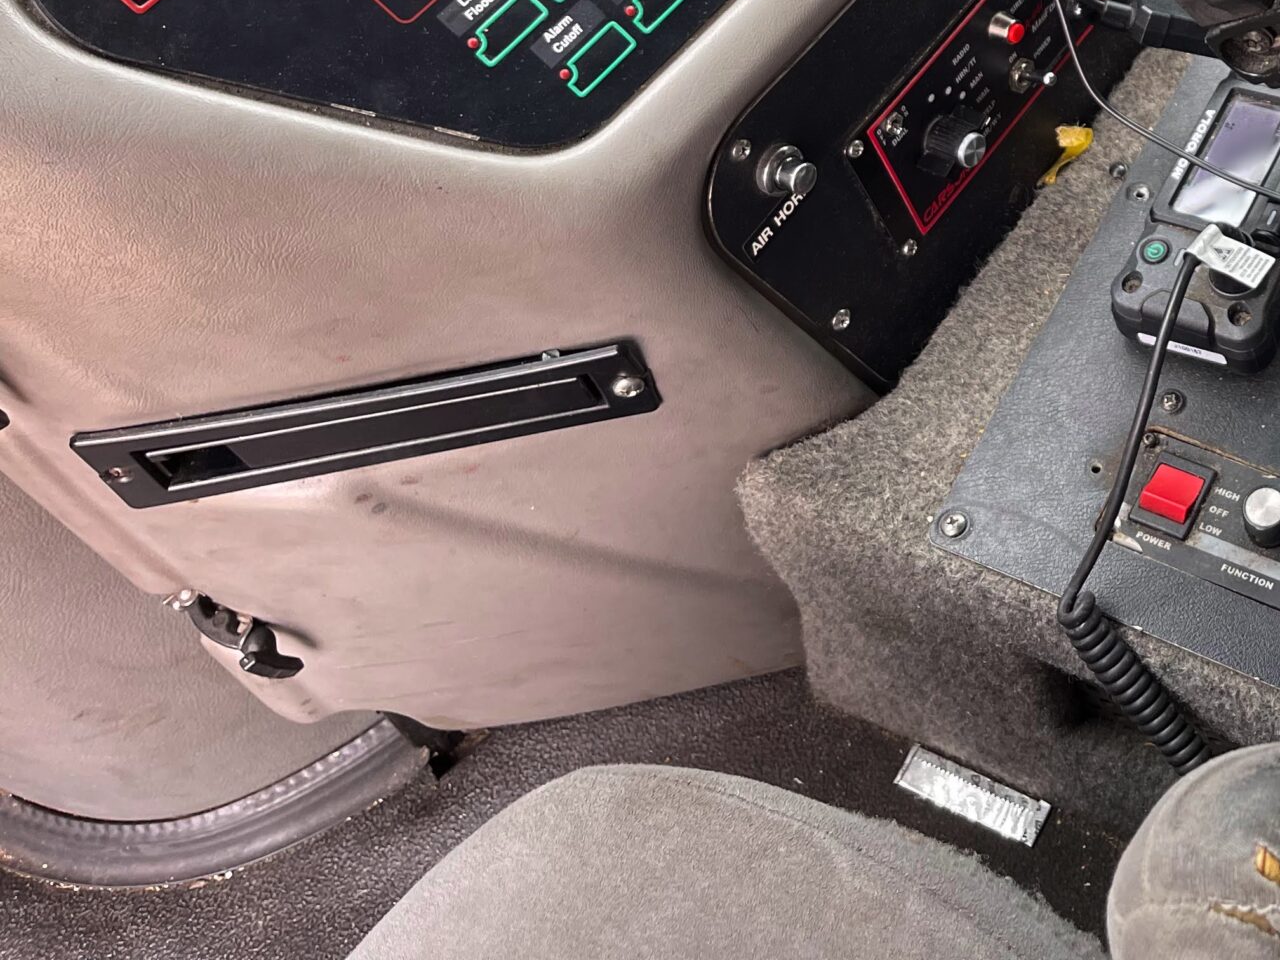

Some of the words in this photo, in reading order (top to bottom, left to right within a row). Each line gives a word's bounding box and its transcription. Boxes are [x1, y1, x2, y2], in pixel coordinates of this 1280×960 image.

[542, 14, 574, 44] Alarm
[552, 23, 584, 54] Cutoff
[952, 43, 970, 66] RADIO
[970, 71, 984, 89] MAN
[1170, 109, 1216, 180] MOOROLA
[752, 226, 774, 256] AIR
[774, 193, 806, 227] HOR
[1215, 486, 1240, 502] HIGH
[1208, 505, 1230, 518] OFF
[1135, 531, 1172, 550] POWER
[1199, 522, 1222, 536] LOW
[1220, 563, 1274, 590] FUNCTION
